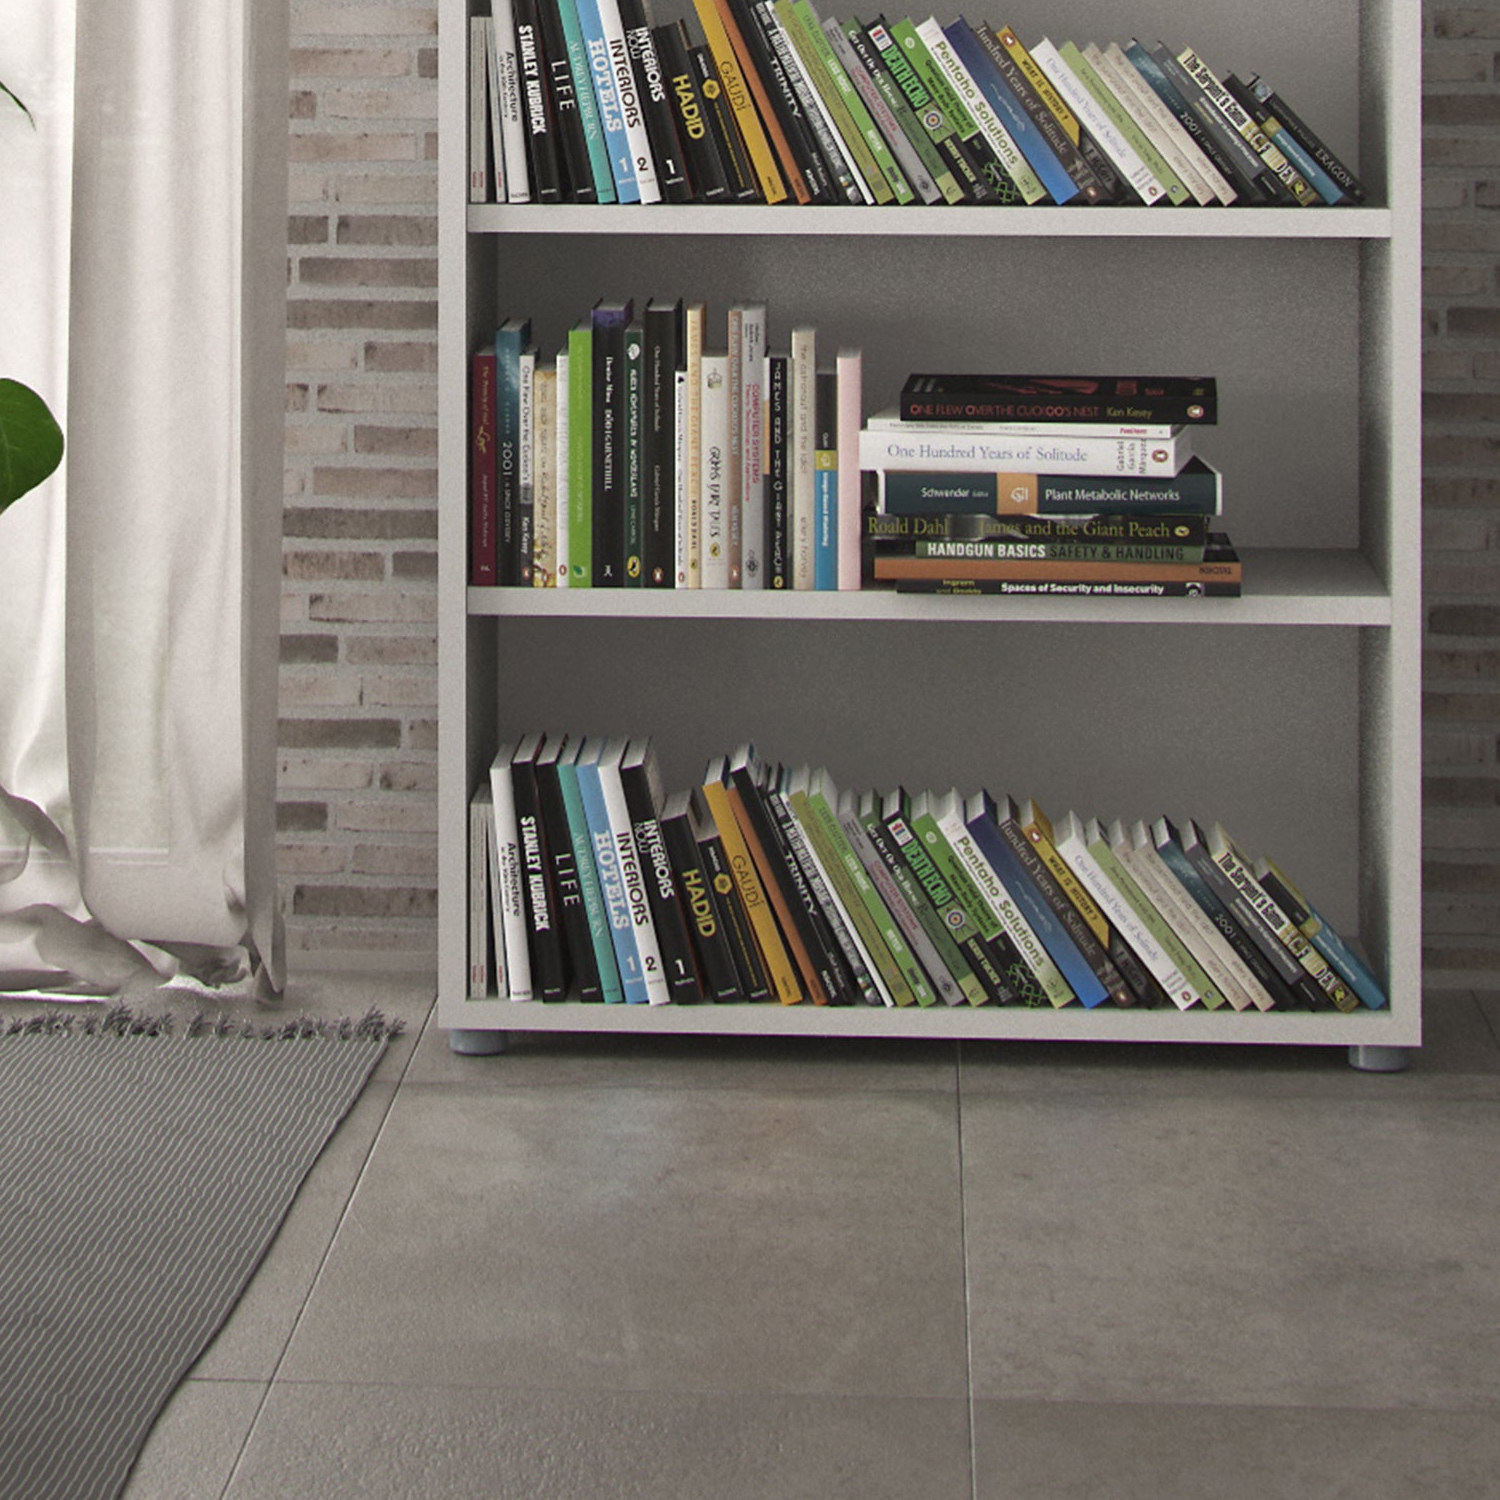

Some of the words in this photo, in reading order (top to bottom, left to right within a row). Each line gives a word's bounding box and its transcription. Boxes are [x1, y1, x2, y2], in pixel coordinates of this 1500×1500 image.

[517, 24, 538, 76] STANLEY
[626, 28, 642, 60] NOW
[634, 25, 665, 103] INTERIORS
[1182, 52, 1203, 74] The
[504, 50, 520, 122] Architecture
[550, 59, 575, 111] LIFE
[587, 36, 622, 133] HOTELS
[609, 38, 641, 129] INTERIORS
[718, 58, 750, 112] GAUDÍ
[768, 55, 801, 120] TRINITY
[878, 43, 914, 84] DEATH
[900, 75, 930, 109] ECHO
[1020, 58, 1038, 79] WHAT
[1034, 78, 1044, 88] IS
[1192, 66, 1232, 110] Serpent's
[525, 79, 546, 134] KUBRICK
[671, 73, 707, 141] HADID
[934, 40, 978, 100] Pentaho
[972, 99, 1021, 165] Solutions
[1003, 67, 1030, 98] Years
[1024, 95, 1040, 111] of
[1033, 109, 1069, 155] Solitude
[1057, 72, 1085, 105] Hundred
[1080, 101, 1099, 123] Years
[1094, 120, 1107, 133] of
[1101, 129, 1128, 160] Solitude
[1178, 110, 1202, 137] 2001
[1223, 101, 1249, 129] Game
[636, 156, 648, 172] 2
[665, 158, 675, 175] 1
[1313, 147, 1353, 190] ERAGON
[690, 361, 698, 386] AND
[751, 383, 760, 436] COMPUTER
[910, 403, 933, 415] ONE
[936, 404, 962, 415] FLEW
[965, 404, 993, 416] OVER
[994, 404, 1014, 416] THE
[1016, 404, 1071, 417] CUCKOO'S
[1073, 405, 1100, 417] NEST
[1106, 407, 1123, 418] Ken
[502, 441, 512, 475] 2001
[751, 439, 759, 483] SYSTEMS
[887, 443, 915, 457] One
[919, 444, 976, 459] Hundred
[979, 445, 1013, 460] Years
[1016, 445, 1031, 460] of
[1035, 446, 1088, 461] Solitude
[921, 487, 969, 498] Schwender
[1045, 488, 1072, 501] Plant
[1075, 489, 1126, 501] Metabolic
[1129, 489, 1180, 501] Networks
[868, 516, 910, 535] Roald
[913, 517, 949, 535] Dahl
[979, 518, 1021, 539] James
[1025, 519, 1052, 536] and
[1056, 519, 1080, 536] the
[1082, 520, 1123, 537] Giant
[1128, 521, 1170, 538] Peach
[927, 542, 994, 558] HANDGUN
[998, 544, 1046, 558] BASICS
[1050, 545, 1098, 559] SAFETY
[1101, 546, 1112, 559] &
[1116, 545, 1184, 560] HANDLING
[1001, 583, 1037, 594] Spaces
[1038, 583, 1048, 593] of
[1050, 583, 1091, 596] Security
[1093, 583, 1111, 594] and
[1113, 583, 1164, 596] Insecurity
[520, 815, 541, 871] STANLEY
[642, 818, 674, 899] INTERIORS
[592, 828, 630, 930] HOTELS
[616, 831, 649, 926] INTERIORS
[782, 850, 817, 917] TRINITY
[899, 836, 936, 881] DEATH
[921, 871, 953, 908] ECHO
[1085, 870, 1115, 905] Hundred
[1110, 902, 1130, 924] Years
[1216, 851, 1238, 873] The
[1227, 865, 1269, 911] Serpent's
[1259, 902, 1288, 931] Game
[528, 873, 549, 931] KUBRICK
[681, 867, 719, 939] HADID
[954, 835, 1003, 898] Pentaho
[996, 898, 1048, 967] Solutions
[1029, 863, 1058, 897] Years
[1050, 894, 1068, 912] of
[1060, 909, 1099, 957] Solitude
[1213, 912, 1238, 939] 2001
